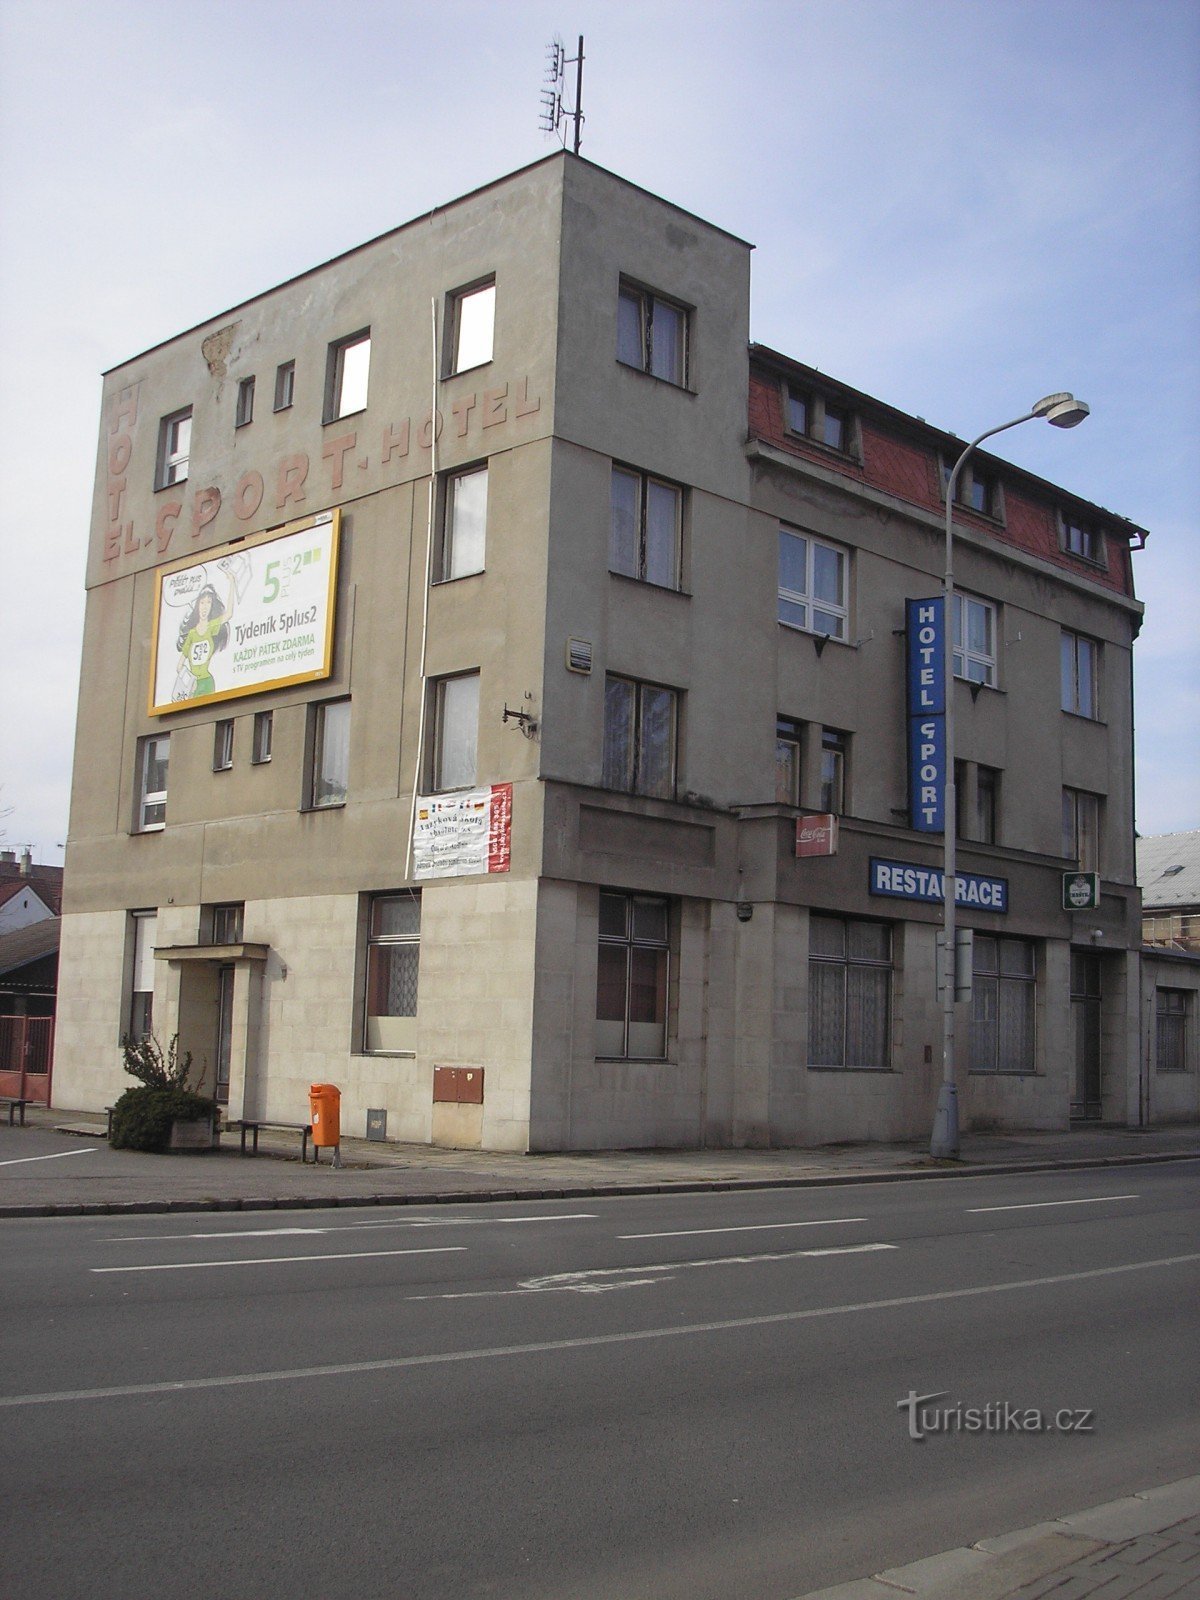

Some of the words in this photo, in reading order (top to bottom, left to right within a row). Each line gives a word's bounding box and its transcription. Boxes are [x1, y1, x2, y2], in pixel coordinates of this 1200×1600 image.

[233, 647, 257, 663] KAŽDÝ
[282, 633, 315, 651] ZDARMA
[235, 615, 277, 646] Týdeník
[279, 605, 317, 634] 5plus2
[919, 606, 936, 707] HOTEL
[920, 722, 937, 825] SPORT
